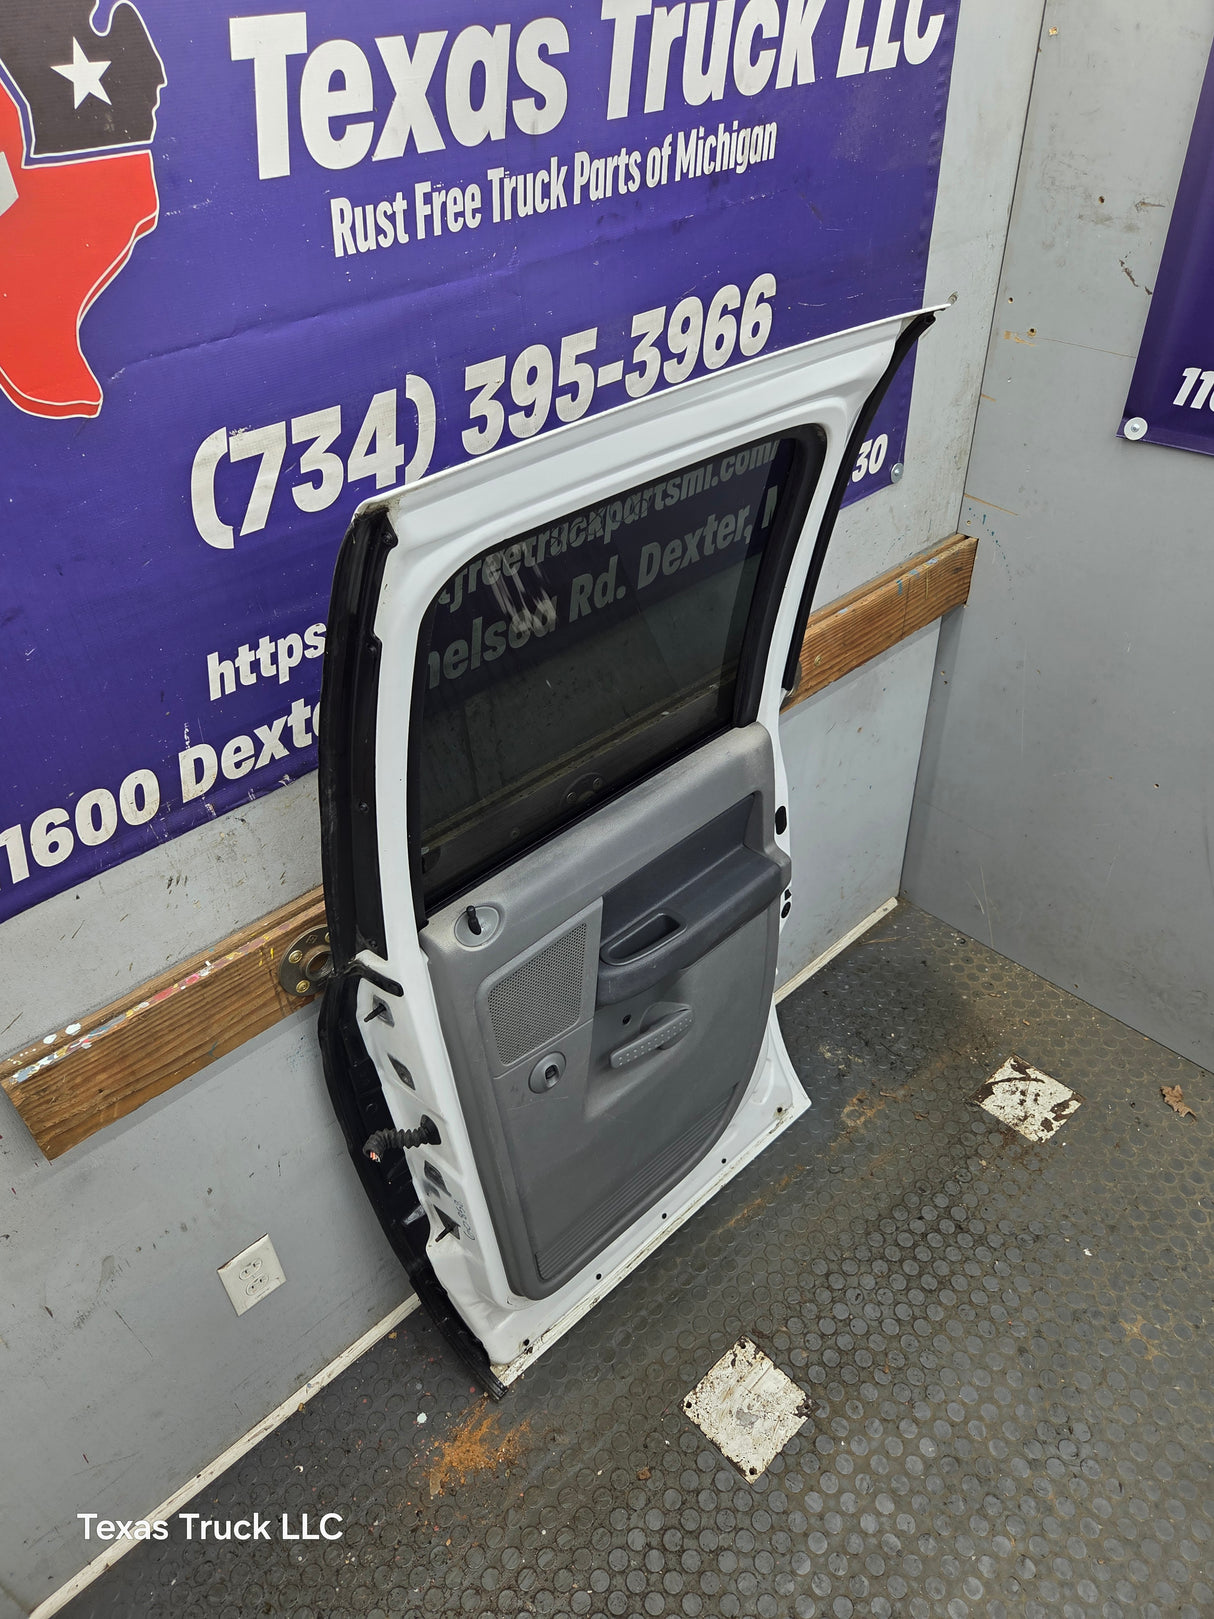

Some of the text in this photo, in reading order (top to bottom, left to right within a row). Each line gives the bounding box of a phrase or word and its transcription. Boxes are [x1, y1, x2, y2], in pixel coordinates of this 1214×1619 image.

[229, 0, 945, 180] Texas Truck LLC
[330, 120, 778, 258] Rust Free Truck Parts of Michigan
[191, 273, 777, 549] (734) 395-3966
[1172, 367, 1214, 412] 11
[568, 554, 627, 623] Rd.
[637, 504, 753, 590] Dexter,
[852, 433, 888, 483] 30
